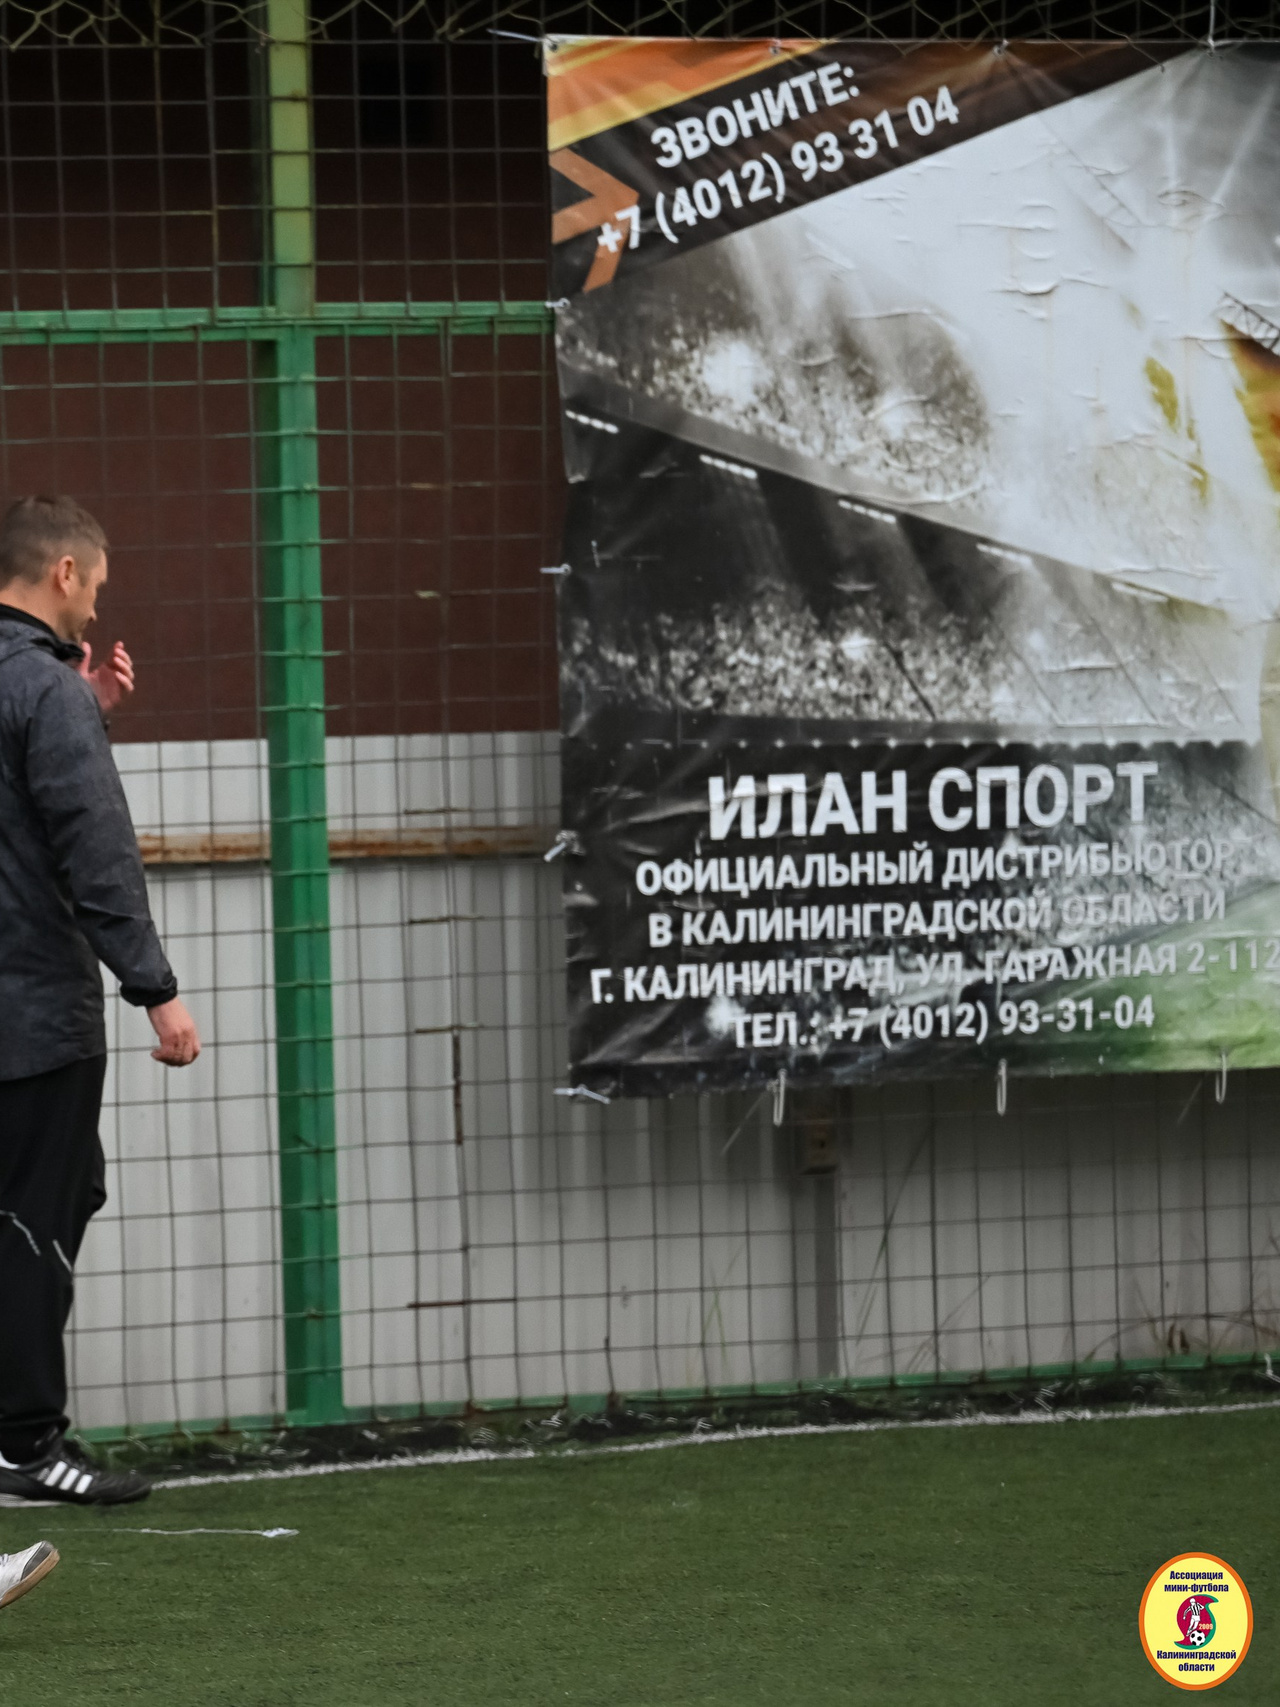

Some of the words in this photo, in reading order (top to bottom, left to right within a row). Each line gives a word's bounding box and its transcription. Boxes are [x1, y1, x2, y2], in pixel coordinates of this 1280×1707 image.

[650, 62, 860, 168] ЗВОНИТЕ:
[597, 204, 641, 253] +7
[655, 152, 786, 245] (4012)
[791, 131, 844, 182] 93
[848, 110, 899, 160] 31
[907, 84, 960, 137] 04
[708, 770, 907, 840] ИЛАН
[928, 761, 1159, 832] СПОРТ
[635, 841, 933, 899] ОФИЦИАЛЬНЫЙ
[941, 839, 1235, 890] ДИСТРИБЬЮТОР
[649, 912, 672, 947] В
[682, 886, 1053, 947] КАЛИНИНГРАДСКОЙ
[1061, 889, 1226, 930] ОБЛАСТИ
[590, 968, 614, 1003] Г.
[623, 956, 905, 1003] КАЛИНИНГРАД,
[984, 942, 1178, 984] ГАРАЖНАЯ
[732, 1010, 819, 1048] ТЕЛ.:
[829, 1007, 868, 1042] +7
[880, 1000, 989, 1050] (4012)
[998, 995, 1156, 1035] 93-31-04
